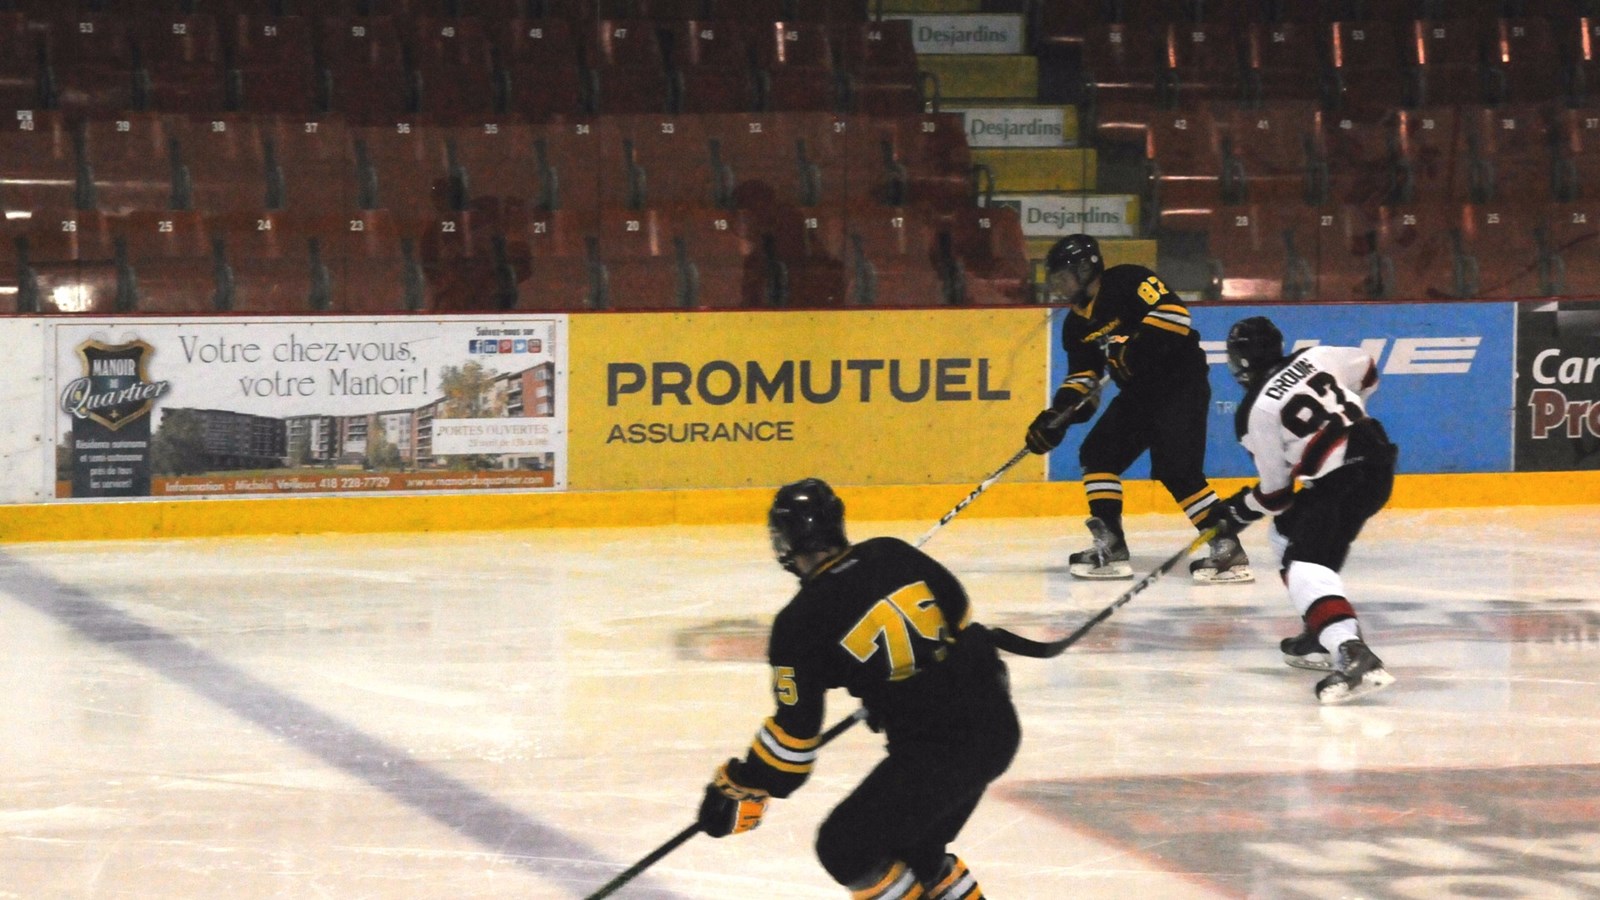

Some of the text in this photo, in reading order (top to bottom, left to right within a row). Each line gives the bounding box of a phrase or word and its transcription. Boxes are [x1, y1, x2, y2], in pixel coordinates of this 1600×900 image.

[79, 22, 94, 33] 53
[172, 23, 186, 34] 52
[264, 25, 277, 37] 51
[352, 26, 365, 37] 50
[614, 28, 627, 38] 47
[918, 26, 1008, 45] Desjardins
[19, 120, 35, 132] 40
[115, 120, 131, 132] 39
[211, 120, 226, 132] 38
[304, 122, 319, 133] 37
[396, 122, 411, 134] 36
[484, 123, 498, 135] 35
[661, 122, 675, 134] 33
[749, 122, 762, 134] 32
[834, 121, 846, 133] 31
[970, 118, 1061, 140] Desjardins
[1174, 119, 1187, 130] 42
[1257, 119, 1270, 130] 41
[1586, 118, 1599, 128] 37
[576, 124, 590, 135] 34
[891, 216, 904, 228] 17
[978, 217, 991, 229] 16
[1027, 206, 1119, 229] Desjardins
[1235, 215, 1249, 227] 28
[1321, 215, 1333, 226] 27
[1402, 214, 1416, 225] 26
[1572, 212, 1586, 224] 24
[61, 219, 77, 233] 26
[158, 220, 174, 233] 25
[257, 219, 272, 231] 24
[349, 219, 364, 232] 23
[441, 221, 456, 233] 22
[533, 221, 546, 234] 21
[625, 220, 640, 232] 20
[713, 219, 728, 231] 19
[178, 333, 417, 364] Votre chez-vous,
[92, 358, 137, 377] MANOIR
[239, 370, 316, 397] votre
[607, 358, 1011, 406] PROMUTUEL
[60, 377, 169, 419] Quartier
[606, 421, 795, 443] ASSURANCE
[319, 478, 337, 488] 418
[341, 477, 390, 488] 228-7729
